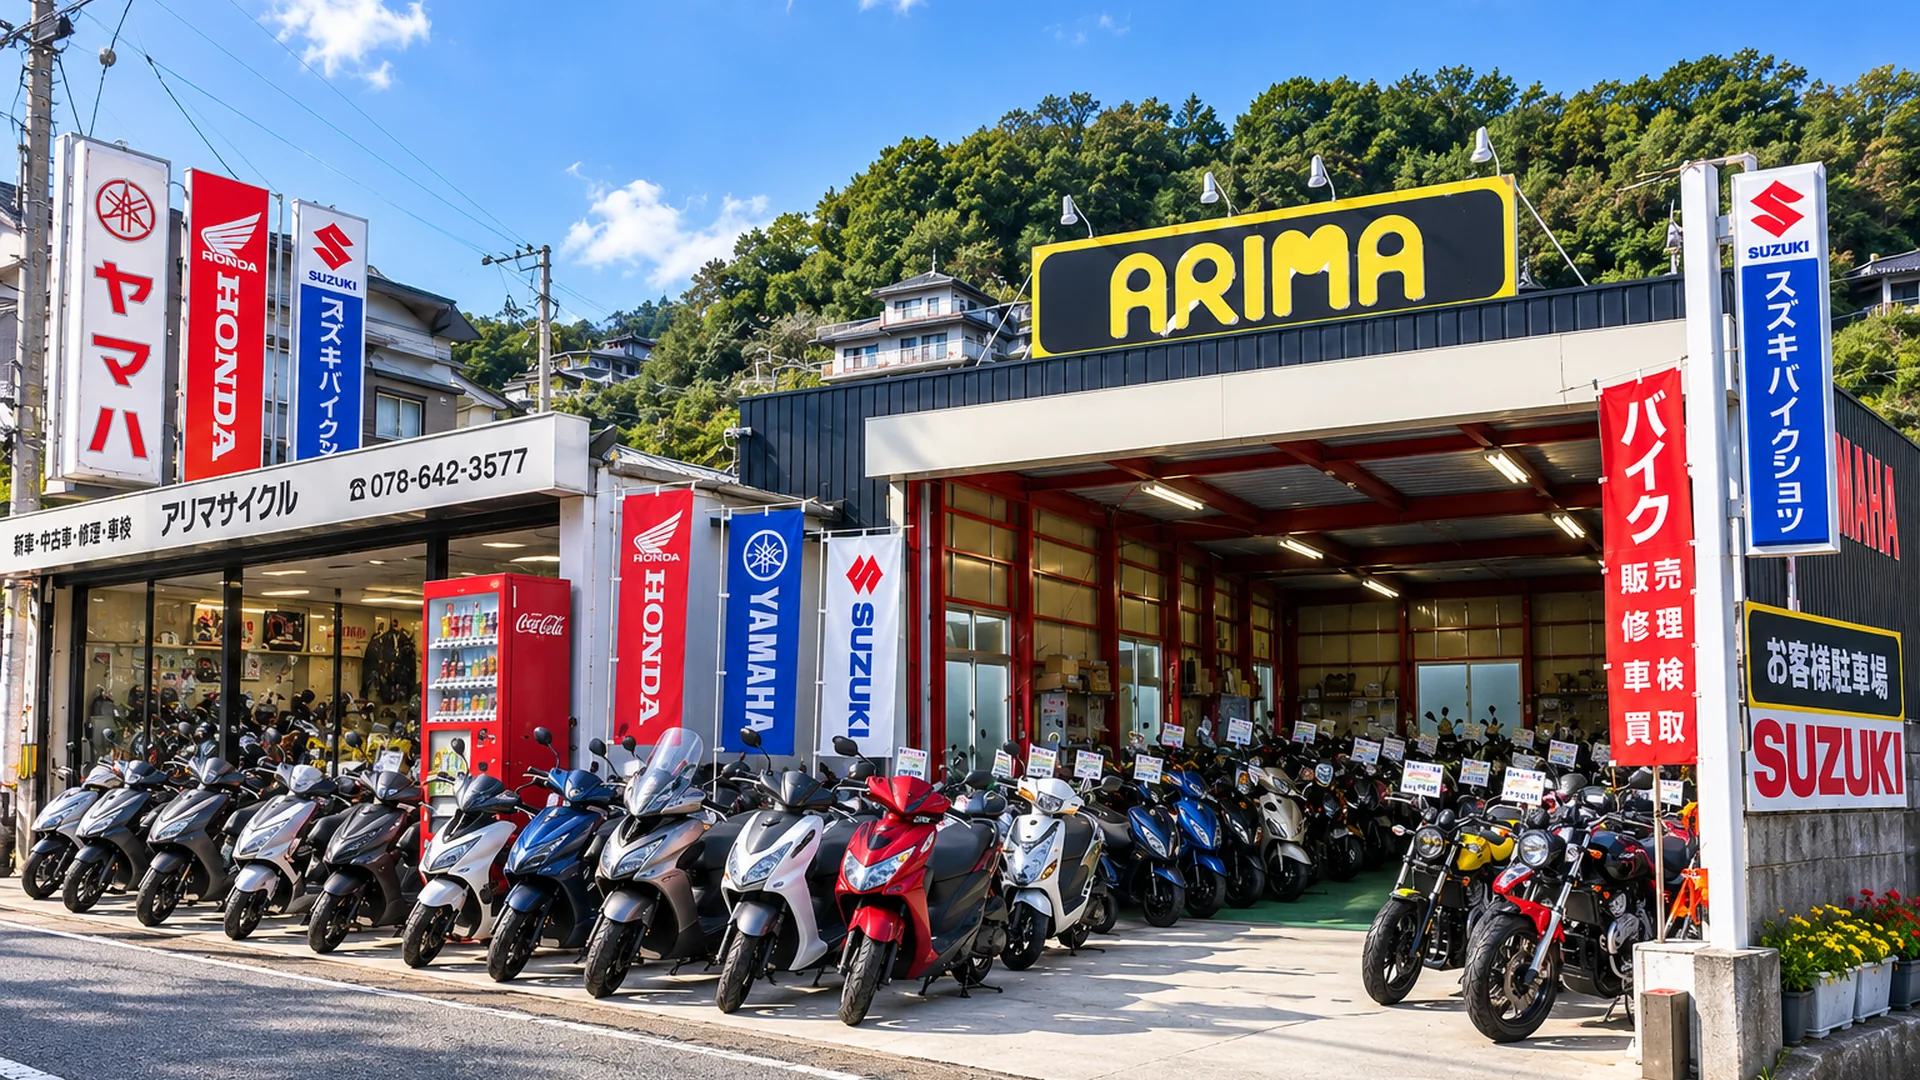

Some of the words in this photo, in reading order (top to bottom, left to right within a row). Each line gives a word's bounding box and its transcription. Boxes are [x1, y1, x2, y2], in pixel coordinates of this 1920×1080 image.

[308, 270, 357, 291] SUZUKI
[1110, 214, 1426, 339] ARIMA
[1748, 240, 1809, 260] SUZUKI
[86, 259, 154, 462] ヤマハ
[212, 271, 240, 462] HONDA
[371, 447, 528, 498] 078-642-3577
[1621, 389, 1670, 546] バイク
[161, 480, 299, 537] アリマサイクル
[1620, 557, 1682, 594] 販売
[639, 569, 666, 726] HONDA
[1621, 606, 1684, 643] 修理
[745, 586, 779, 734] YAMAHA
[848, 602, 875, 739] SUZUKI
[1623, 656, 1685, 693] 車検
[1766, 636, 1889, 701] お客様駐車場
[1625, 710, 1686, 746] 買取
[1753, 718, 1904, 799] SUZUKI
